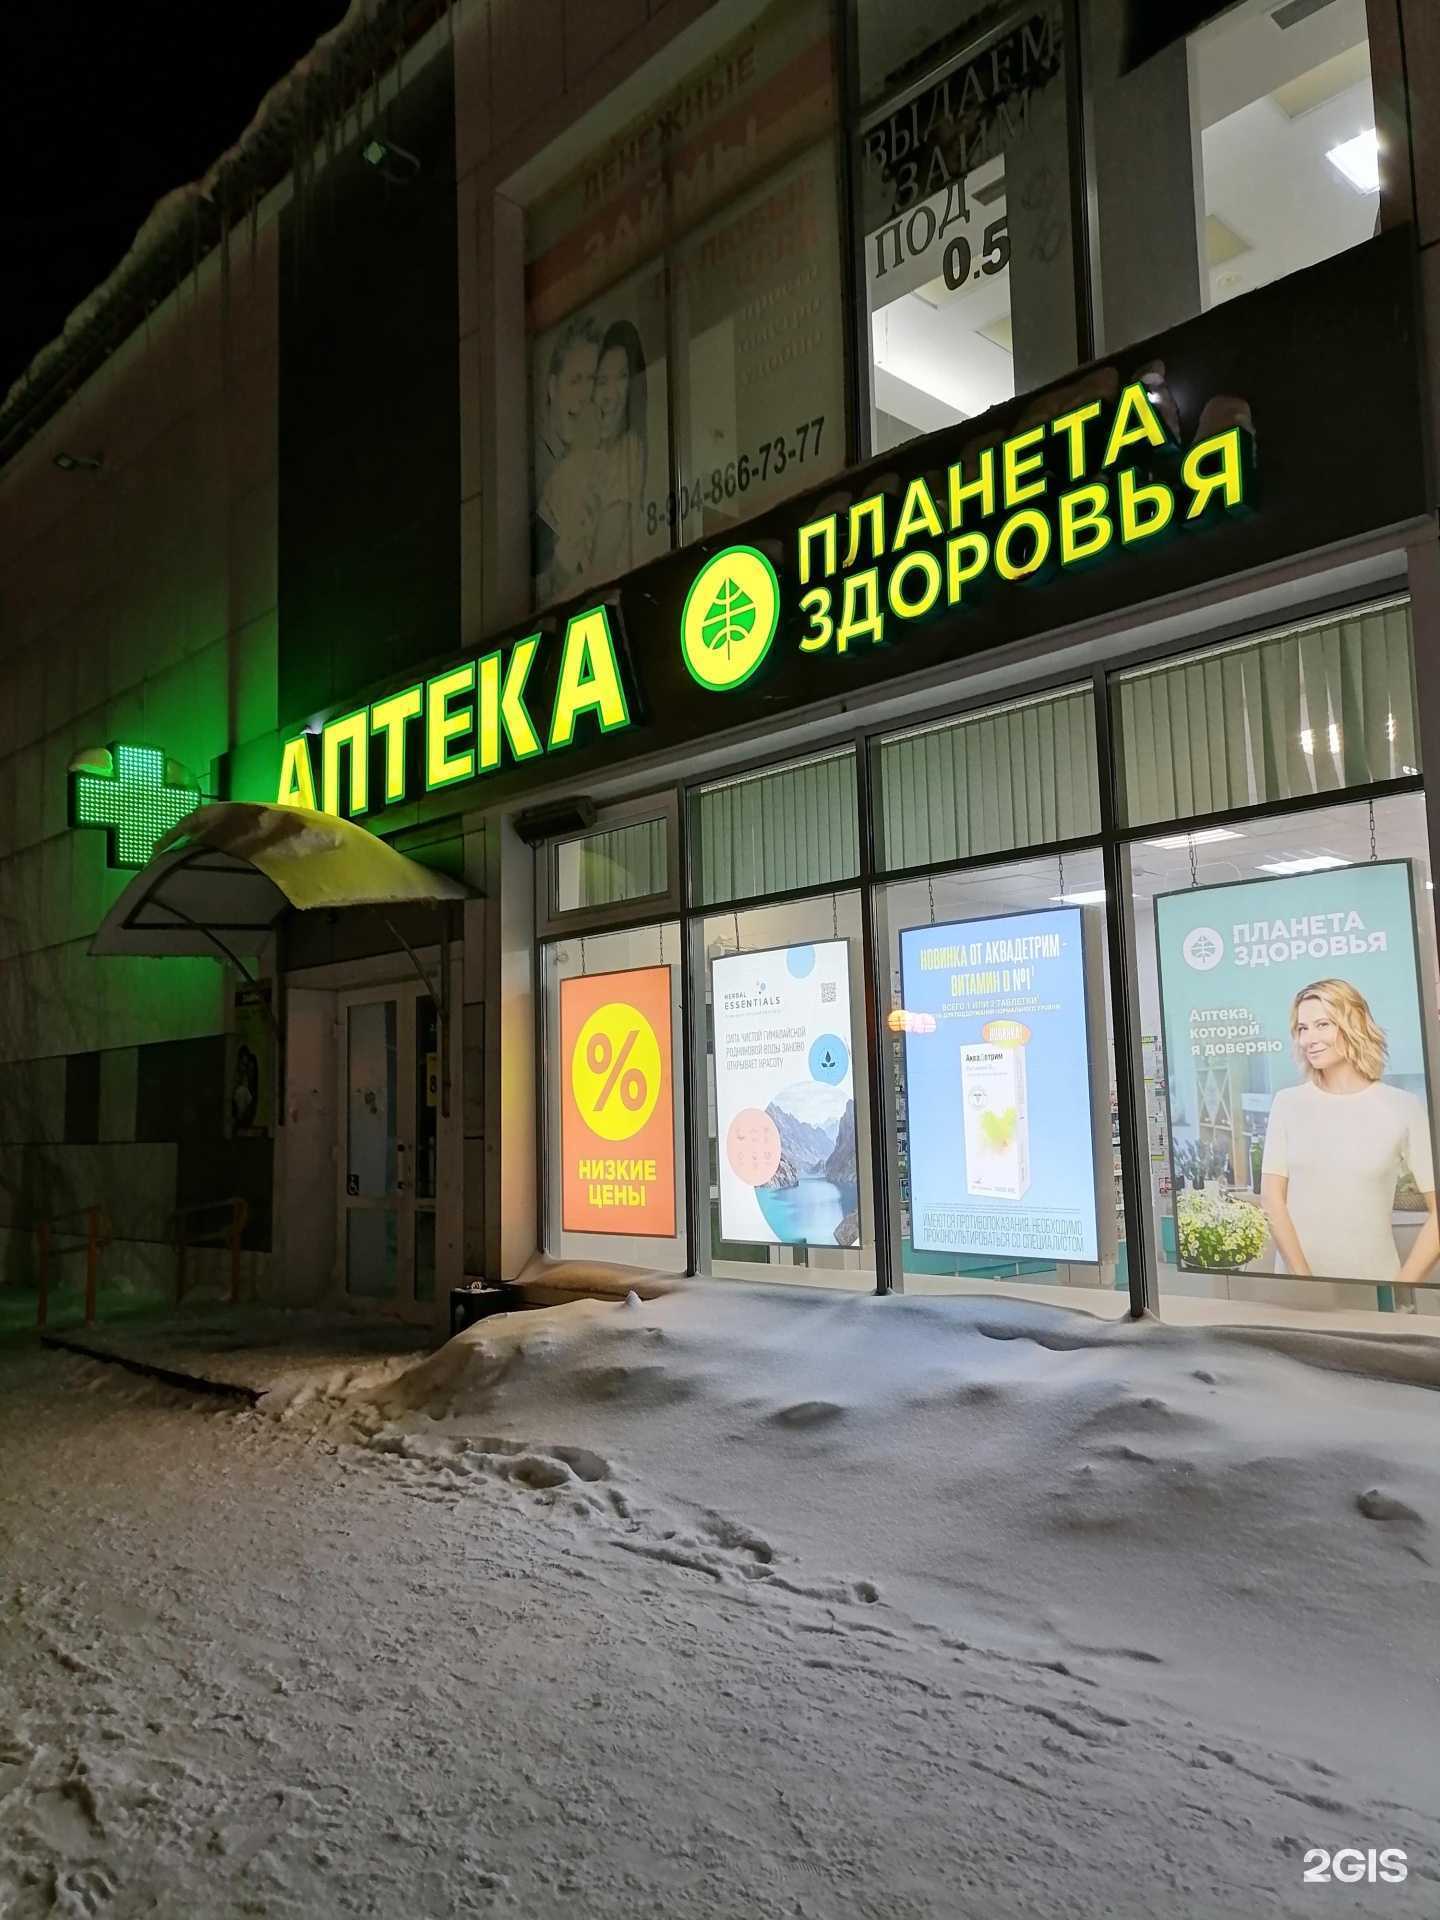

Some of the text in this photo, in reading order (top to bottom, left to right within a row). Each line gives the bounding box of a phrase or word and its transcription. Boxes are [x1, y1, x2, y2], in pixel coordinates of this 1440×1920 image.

[876, 175, 970, 278] ПОД
[797, 380, 1166, 585] ПЛАНЕТА
[798, 425, 1244, 656] ЗДОРОВЬЯ
[277, 604, 632, 817] АПТЕКА
[1232, 911, 1366, 944] ПЛАНЕТА
[920, 945, 968, 971] НОВИНКА
[970, 942, 983, 966] ОТ
[985, 933, 1060, 964] АКВАДЕТРИМ
[1233, 931, 1388, 967] ЗДОРОВЬЯ
[951, 970, 1000, 997] ВИТАМИН
[724, 996, 781, 1010] ESSENTIALS
[1188, 1006, 1254, 1023] Аптека,
[1189, 1021, 1260, 1039] которой
[1191, 1039, 1282, 1057] я доверяю
[578, 1159, 657, 1181] НИЗКИЕ
[588, 1183, 647, 1209] ЦЕНЫ
